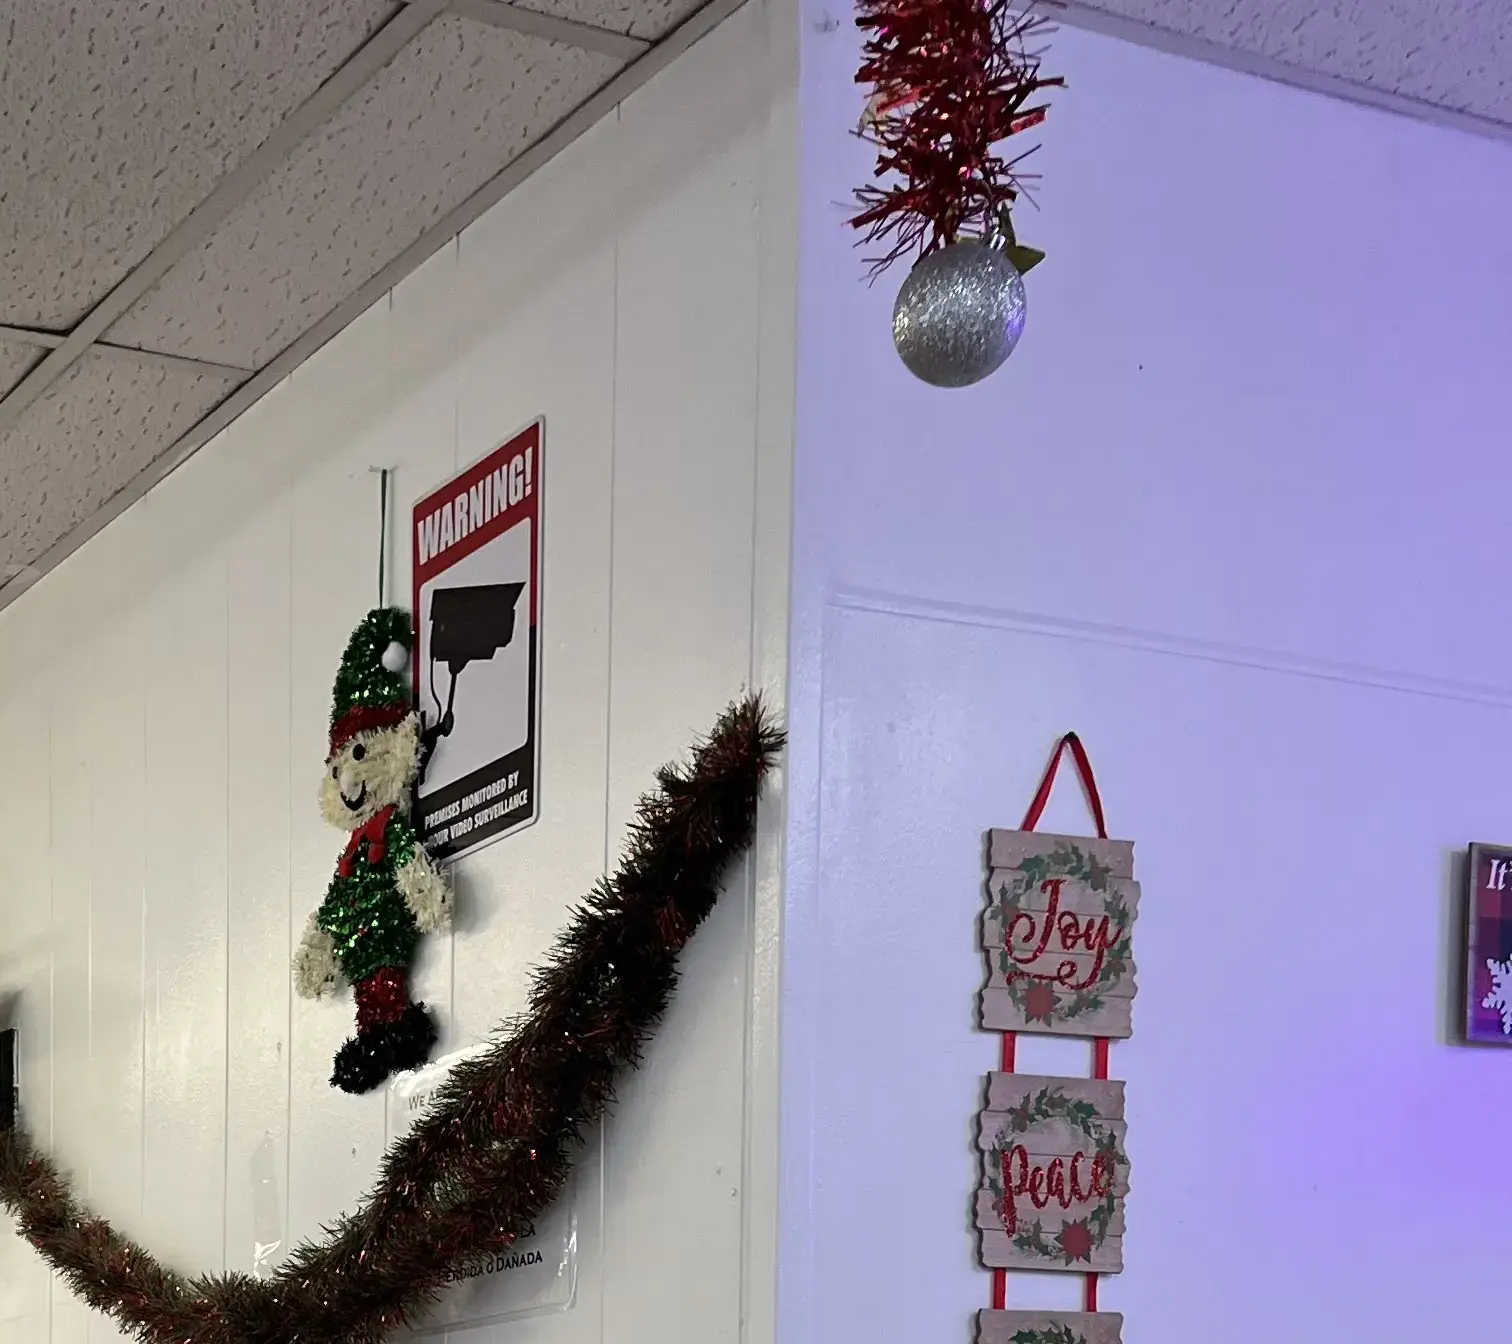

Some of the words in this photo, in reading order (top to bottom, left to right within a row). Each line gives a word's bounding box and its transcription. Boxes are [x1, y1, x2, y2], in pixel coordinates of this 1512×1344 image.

[417, 446, 533, 566] WARNING!
[424, 800, 460, 830] PREMISES
[461, 777, 507, 812] MONITORED
[508, 770, 519, 789] BY
[449, 816, 473, 839] VIDEO
[474, 788, 527, 828] SURVEILLANCE
[1005, 877, 1123, 989] Joy
[999, 1146, 1116, 1238] Peace
